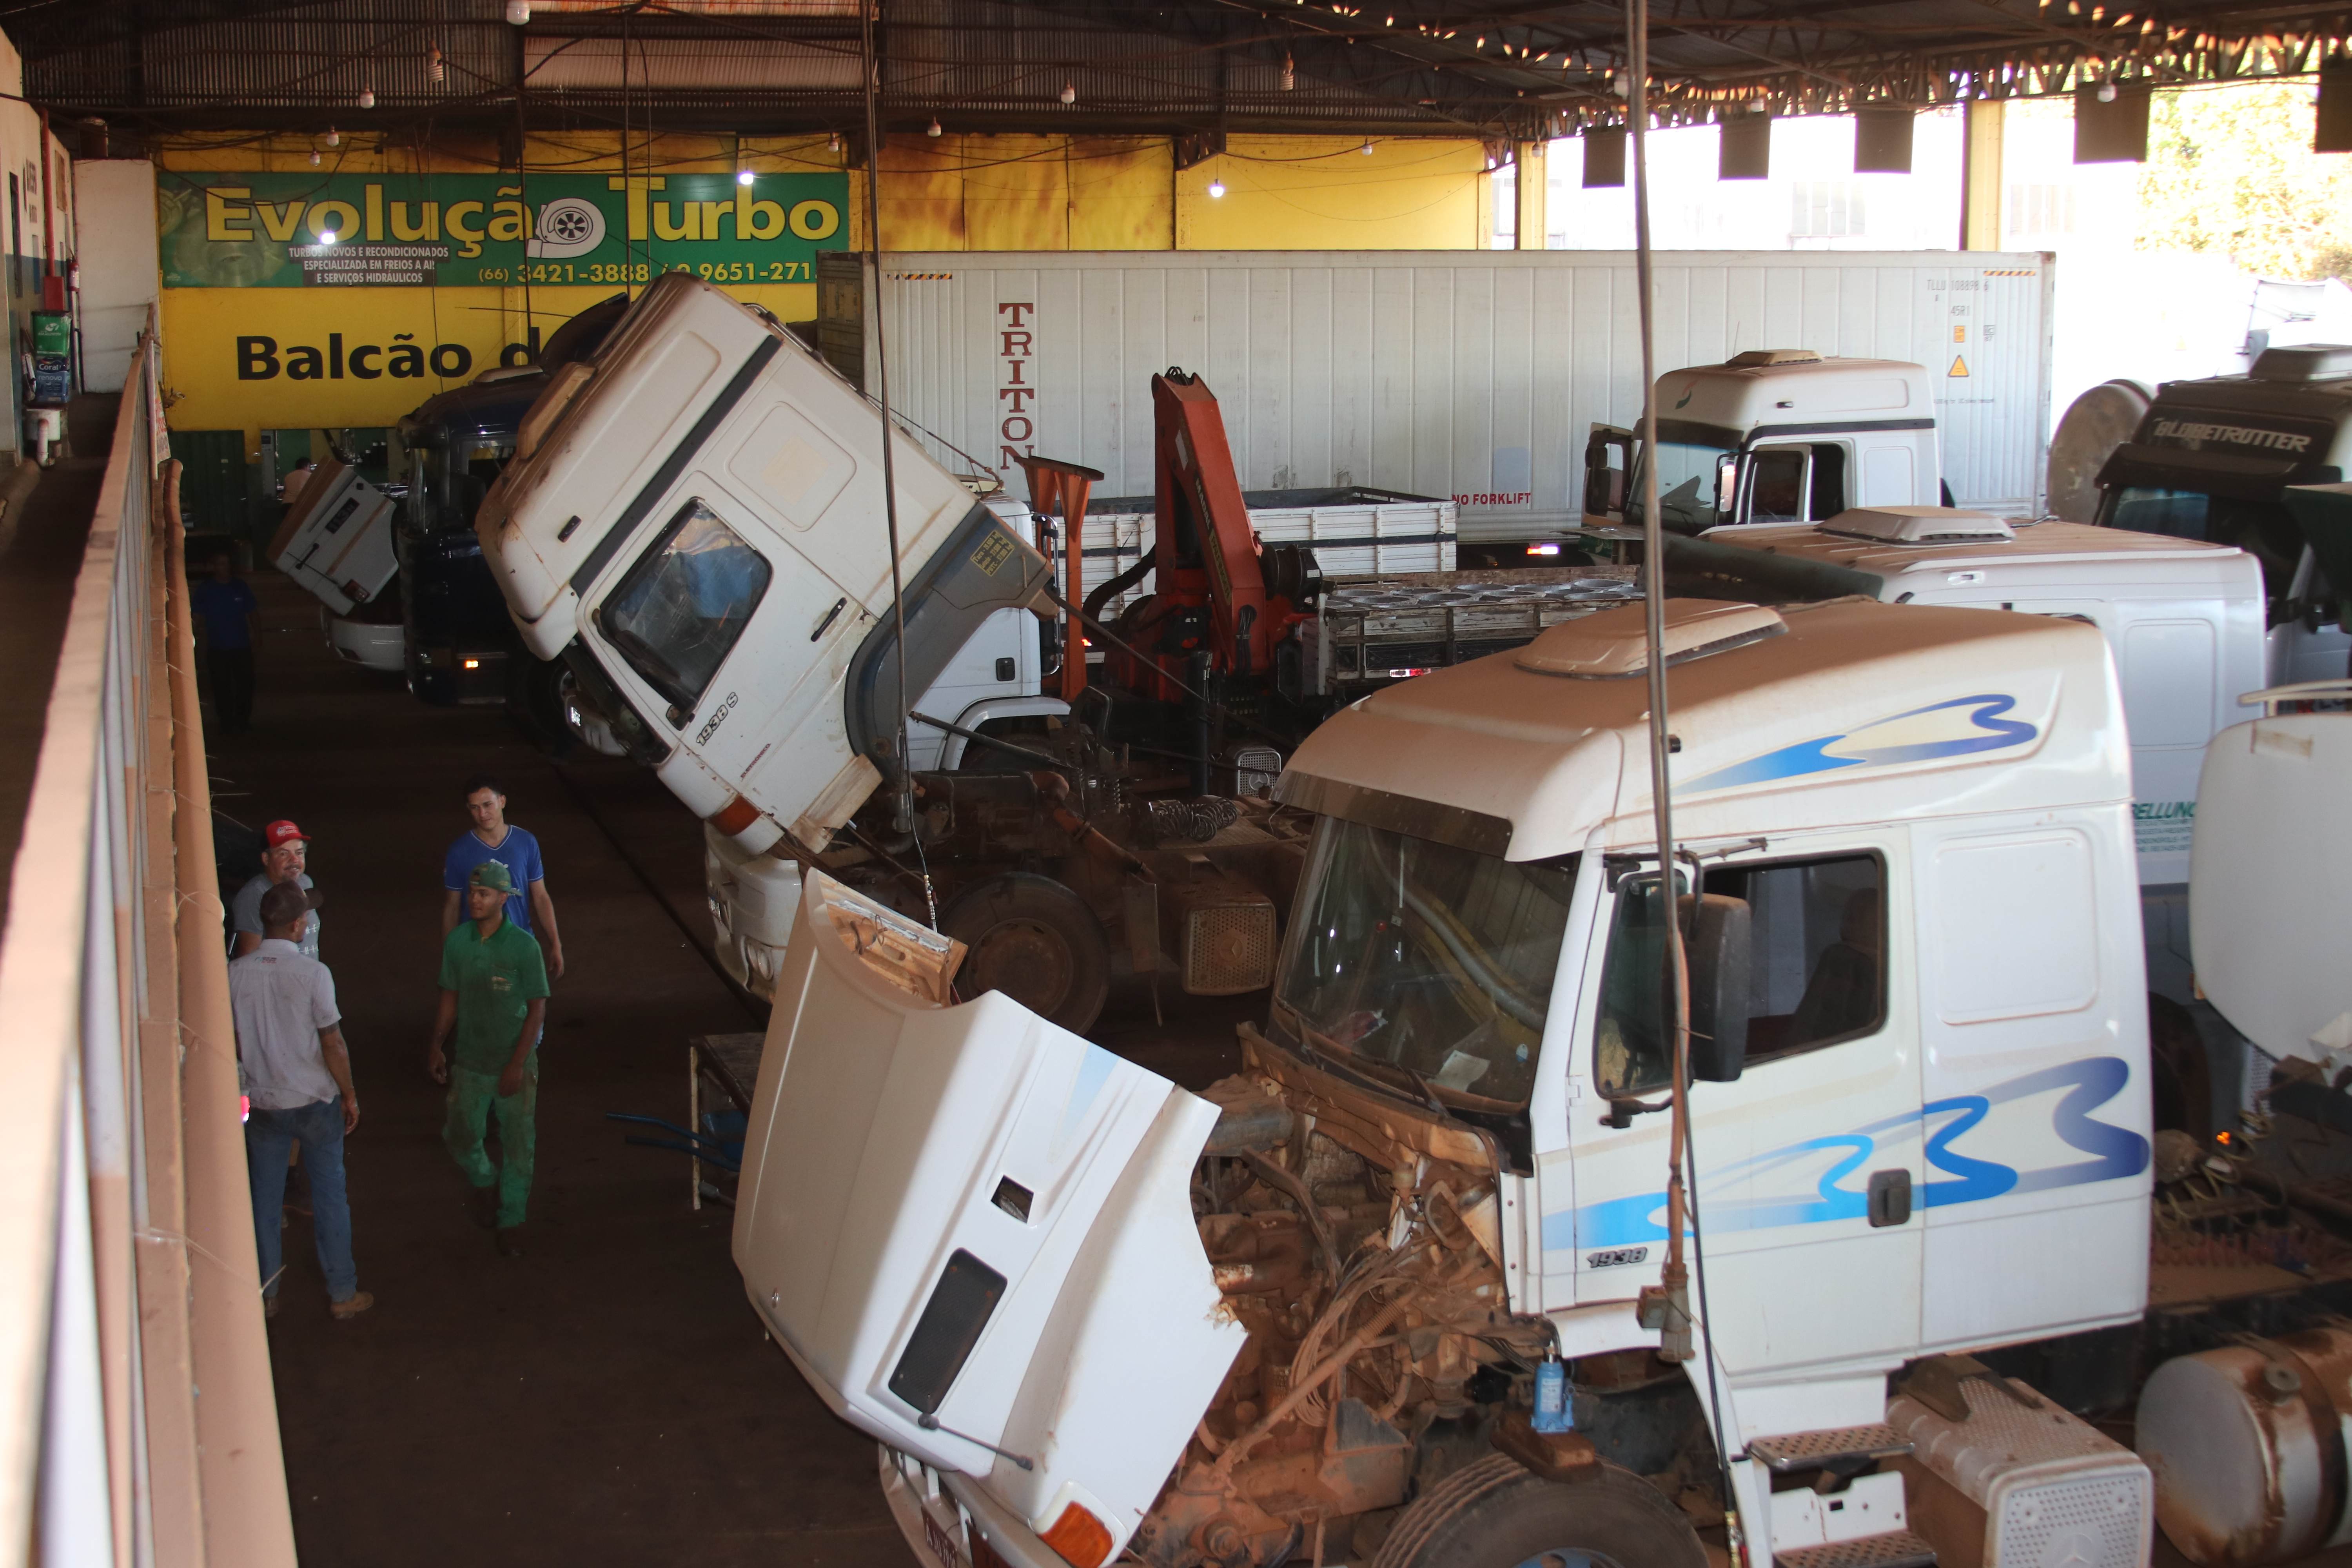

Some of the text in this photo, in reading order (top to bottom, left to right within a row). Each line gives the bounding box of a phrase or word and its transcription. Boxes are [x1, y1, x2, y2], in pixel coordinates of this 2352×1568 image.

[608, 176, 840, 242] Turbo
[289, 247, 448, 257] TURBOS NOVOS E RECONDICIONADOS
[304, 260, 435, 270] ESPECIALIZADA EM FREIOS A AR
[479, 268, 509, 283] (66)
[517, 263, 650, 283] 3421-3888
[699, 262, 818, 281] 9651-271
[317, 270, 423, 285] E SERVIÇOS HIDRÁULICOS
[236, 332, 472, 381] Balcão
[998, 303, 1035, 470] TRITON
[1452, 492, 1531, 505] NO FORKLIFT
[696, 691, 739, 746] 1938 S
[1586, 1246, 1648, 1268] 1938
